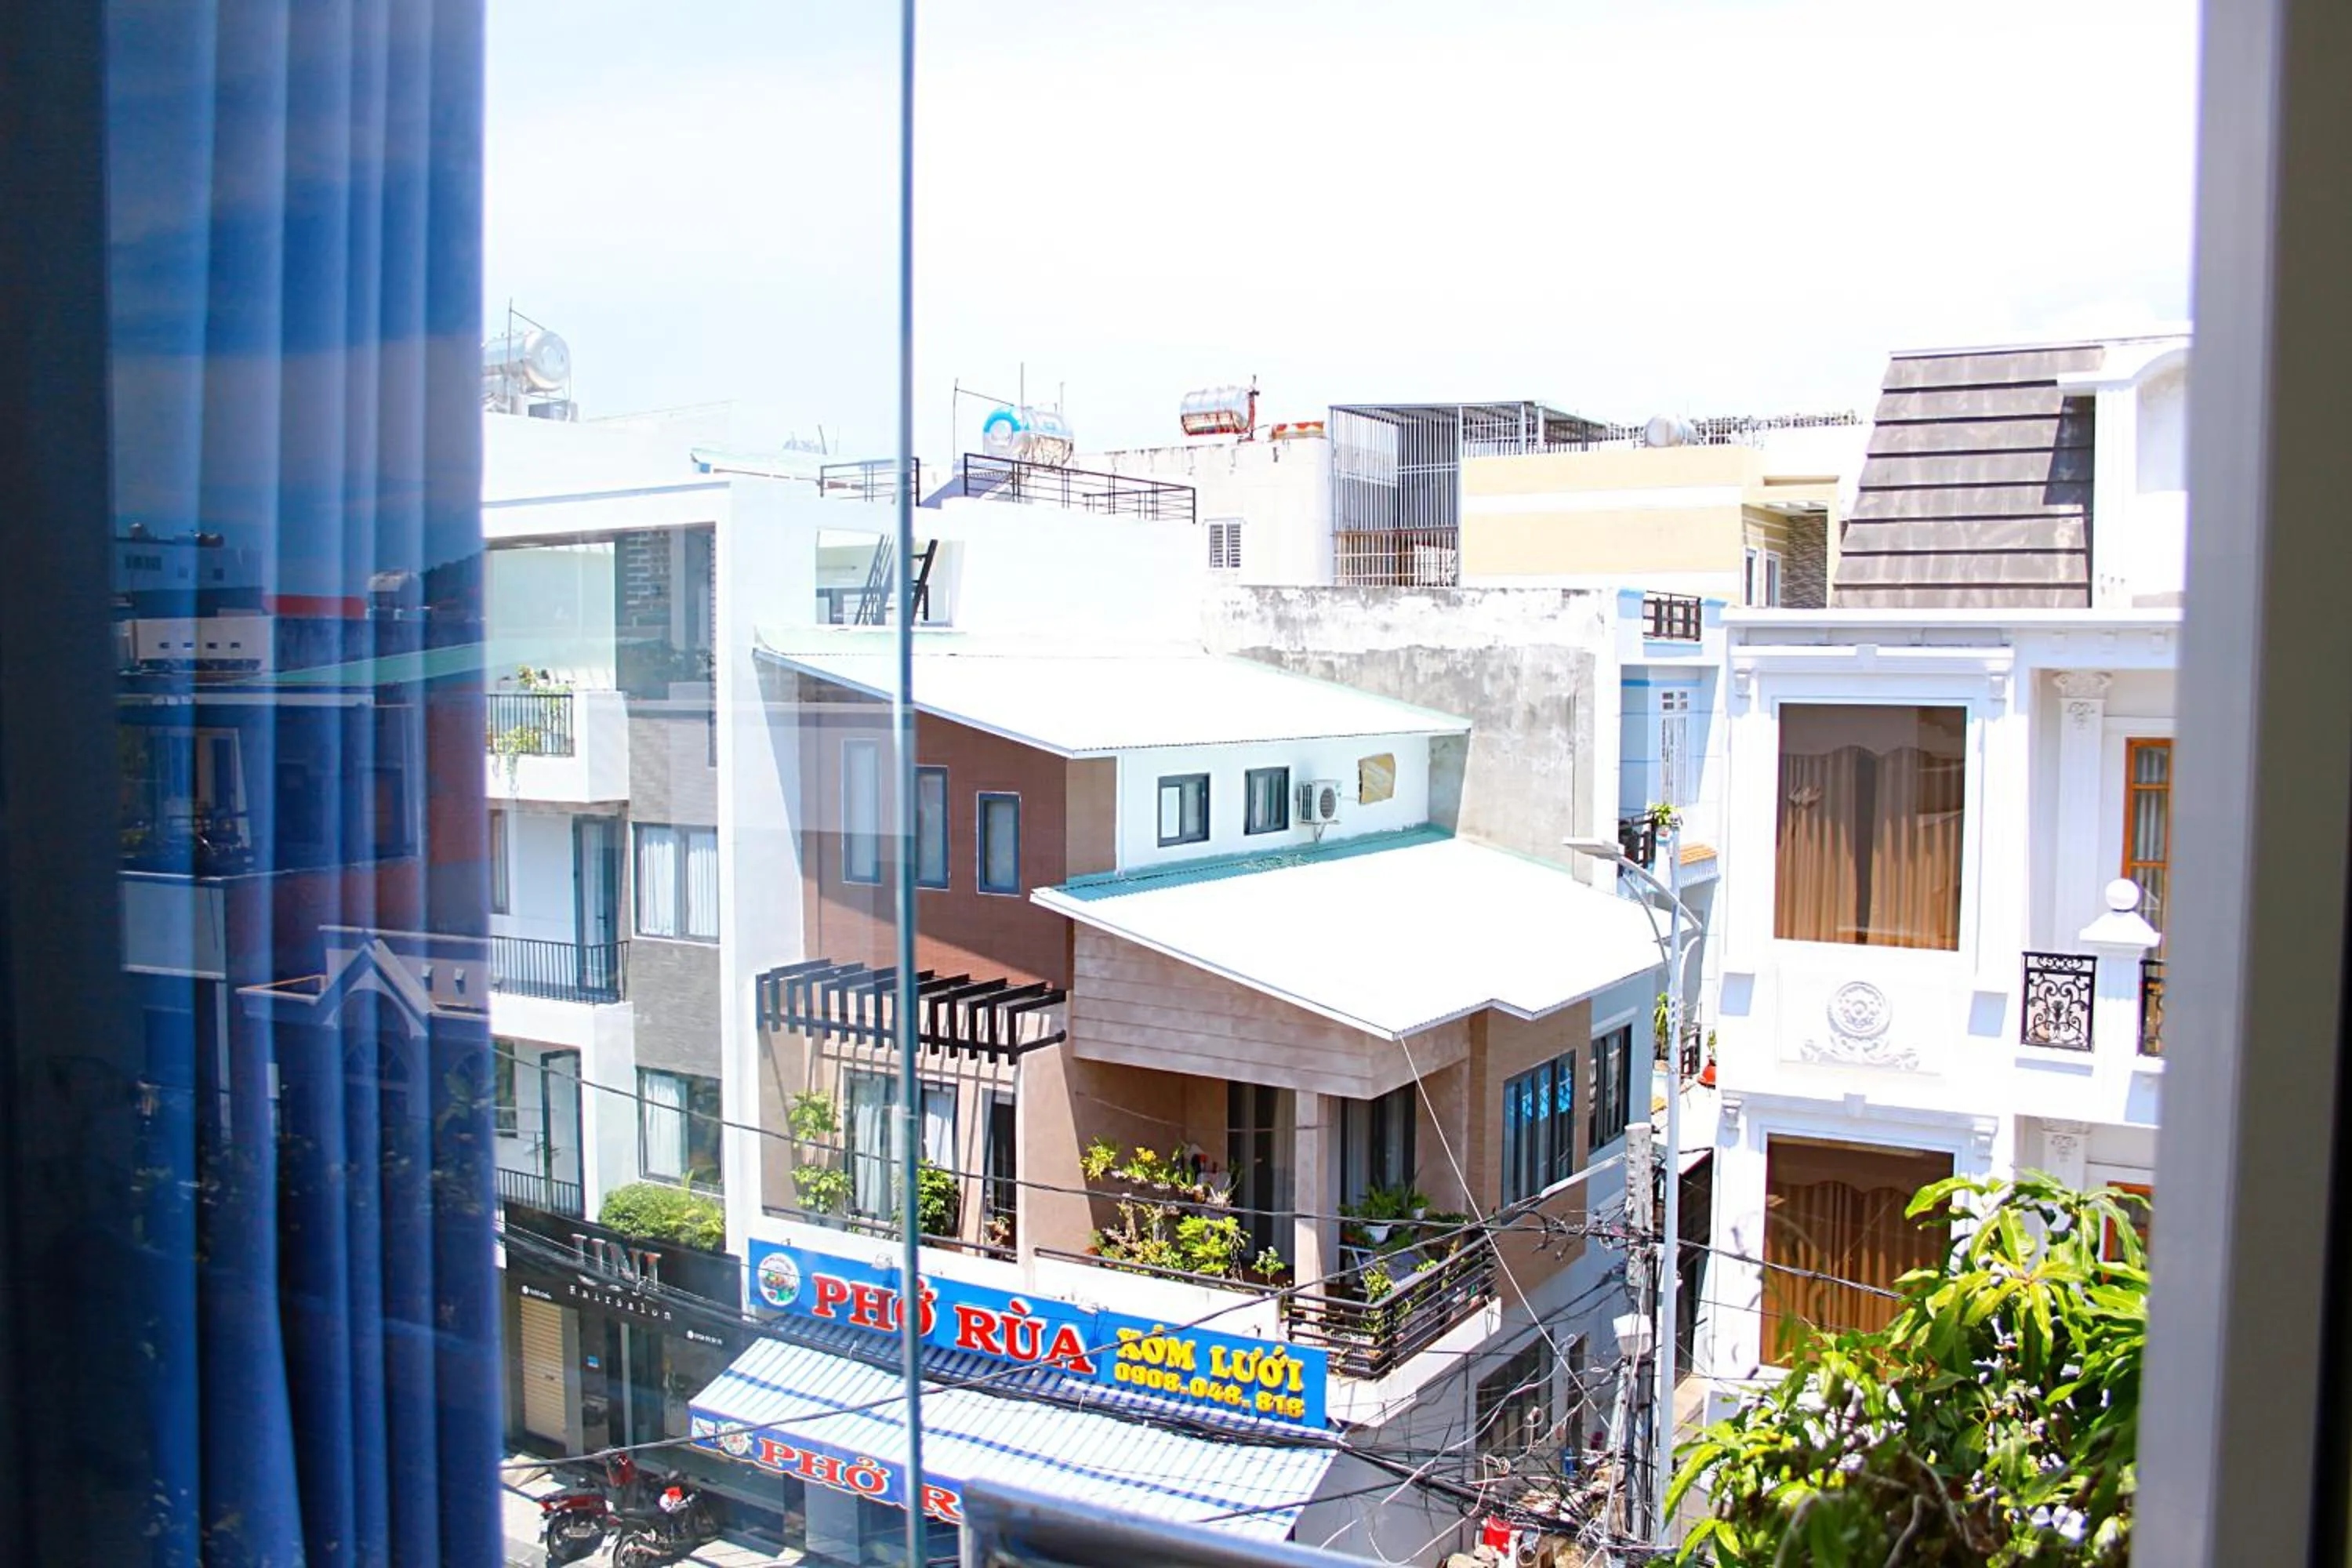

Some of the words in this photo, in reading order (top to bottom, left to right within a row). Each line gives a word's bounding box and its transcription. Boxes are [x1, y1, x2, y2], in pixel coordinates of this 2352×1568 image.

[954, 1298, 1096, 1374] RÙA
[1116, 1324, 1196, 1370] XÓM
[1210, 1345, 1304, 1392] LƯỚI
[758, 1437, 891, 1495] PHỞ
